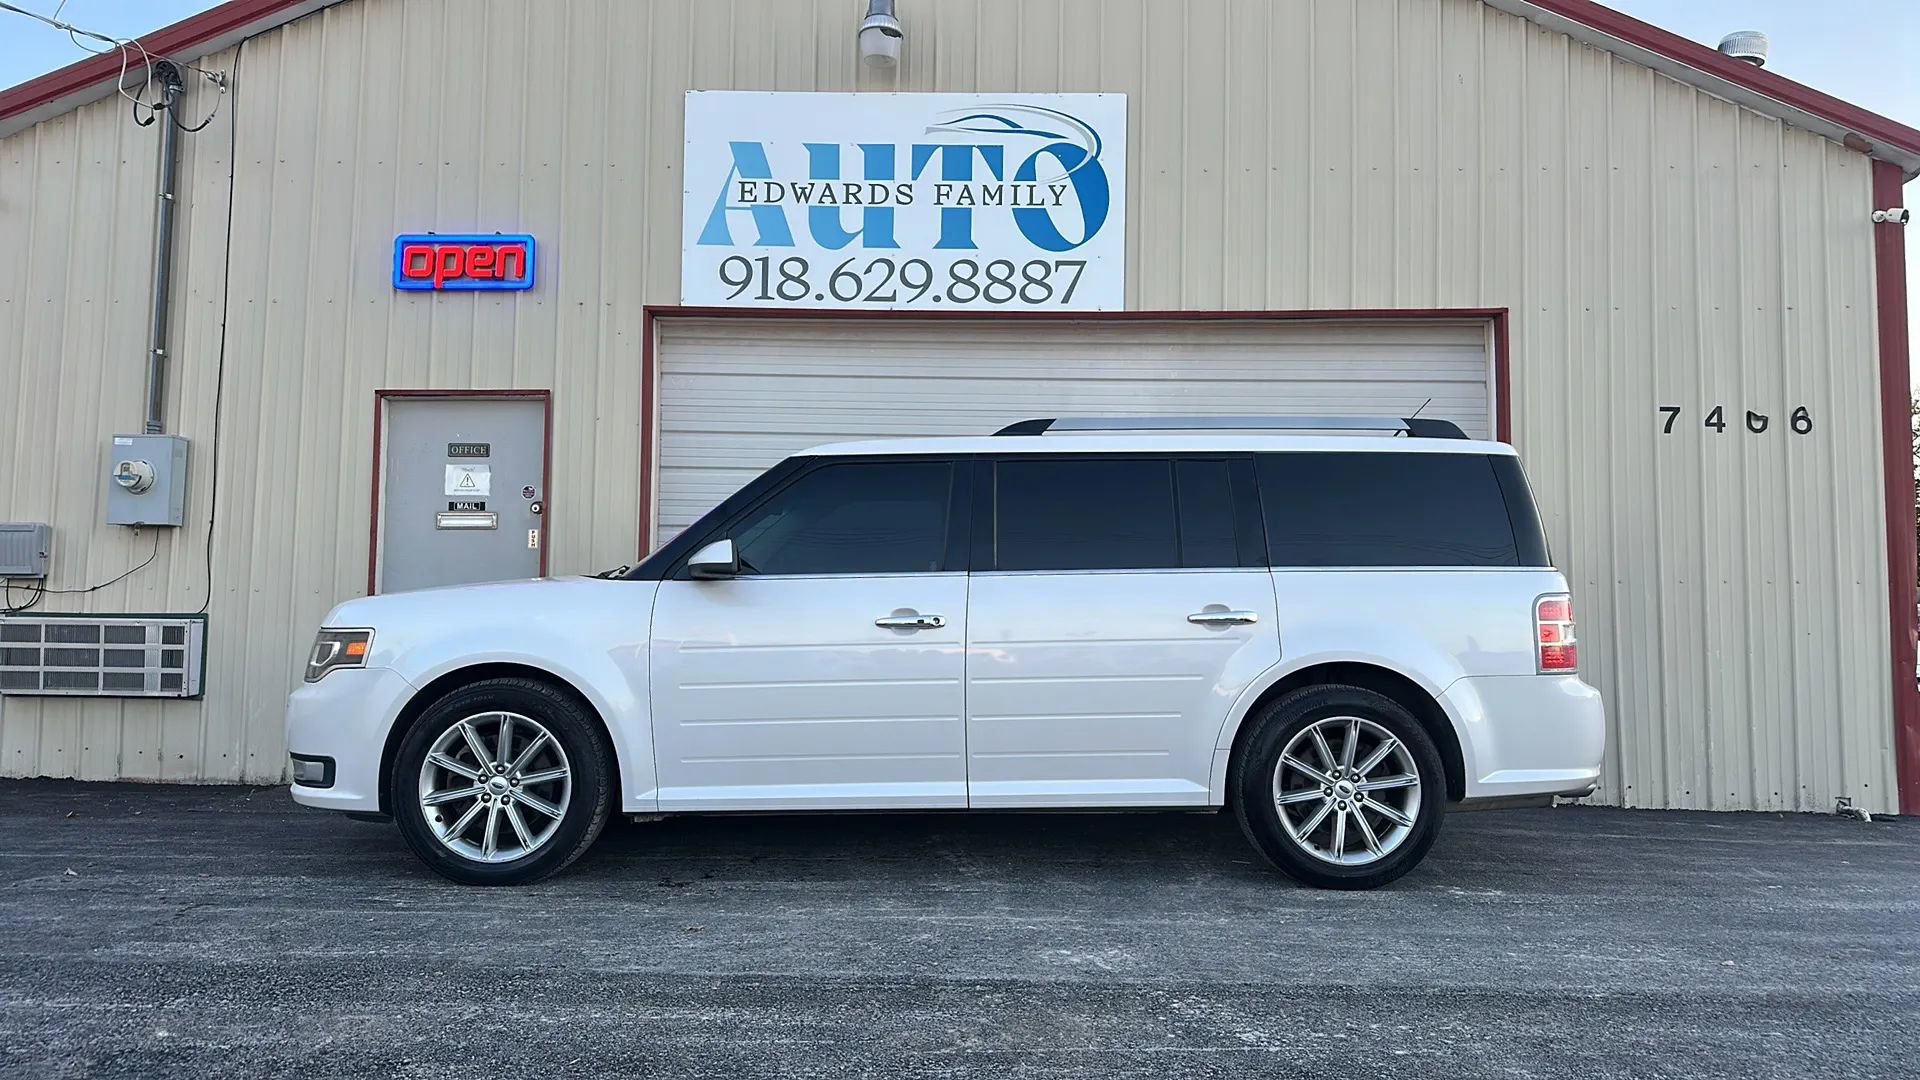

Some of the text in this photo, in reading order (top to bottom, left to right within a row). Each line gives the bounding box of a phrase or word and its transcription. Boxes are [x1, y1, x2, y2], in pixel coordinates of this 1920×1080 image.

[696, 141, 1110, 252] AUTO
[738, 181, 1069, 207] EDWARDS FAMILY
[402, 245, 525, 289] open
[719, 255, 1088, 304] 918.629.8887
[451, 446, 487, 454] OFFICE
[456, 502, 478, 510] MAIL
